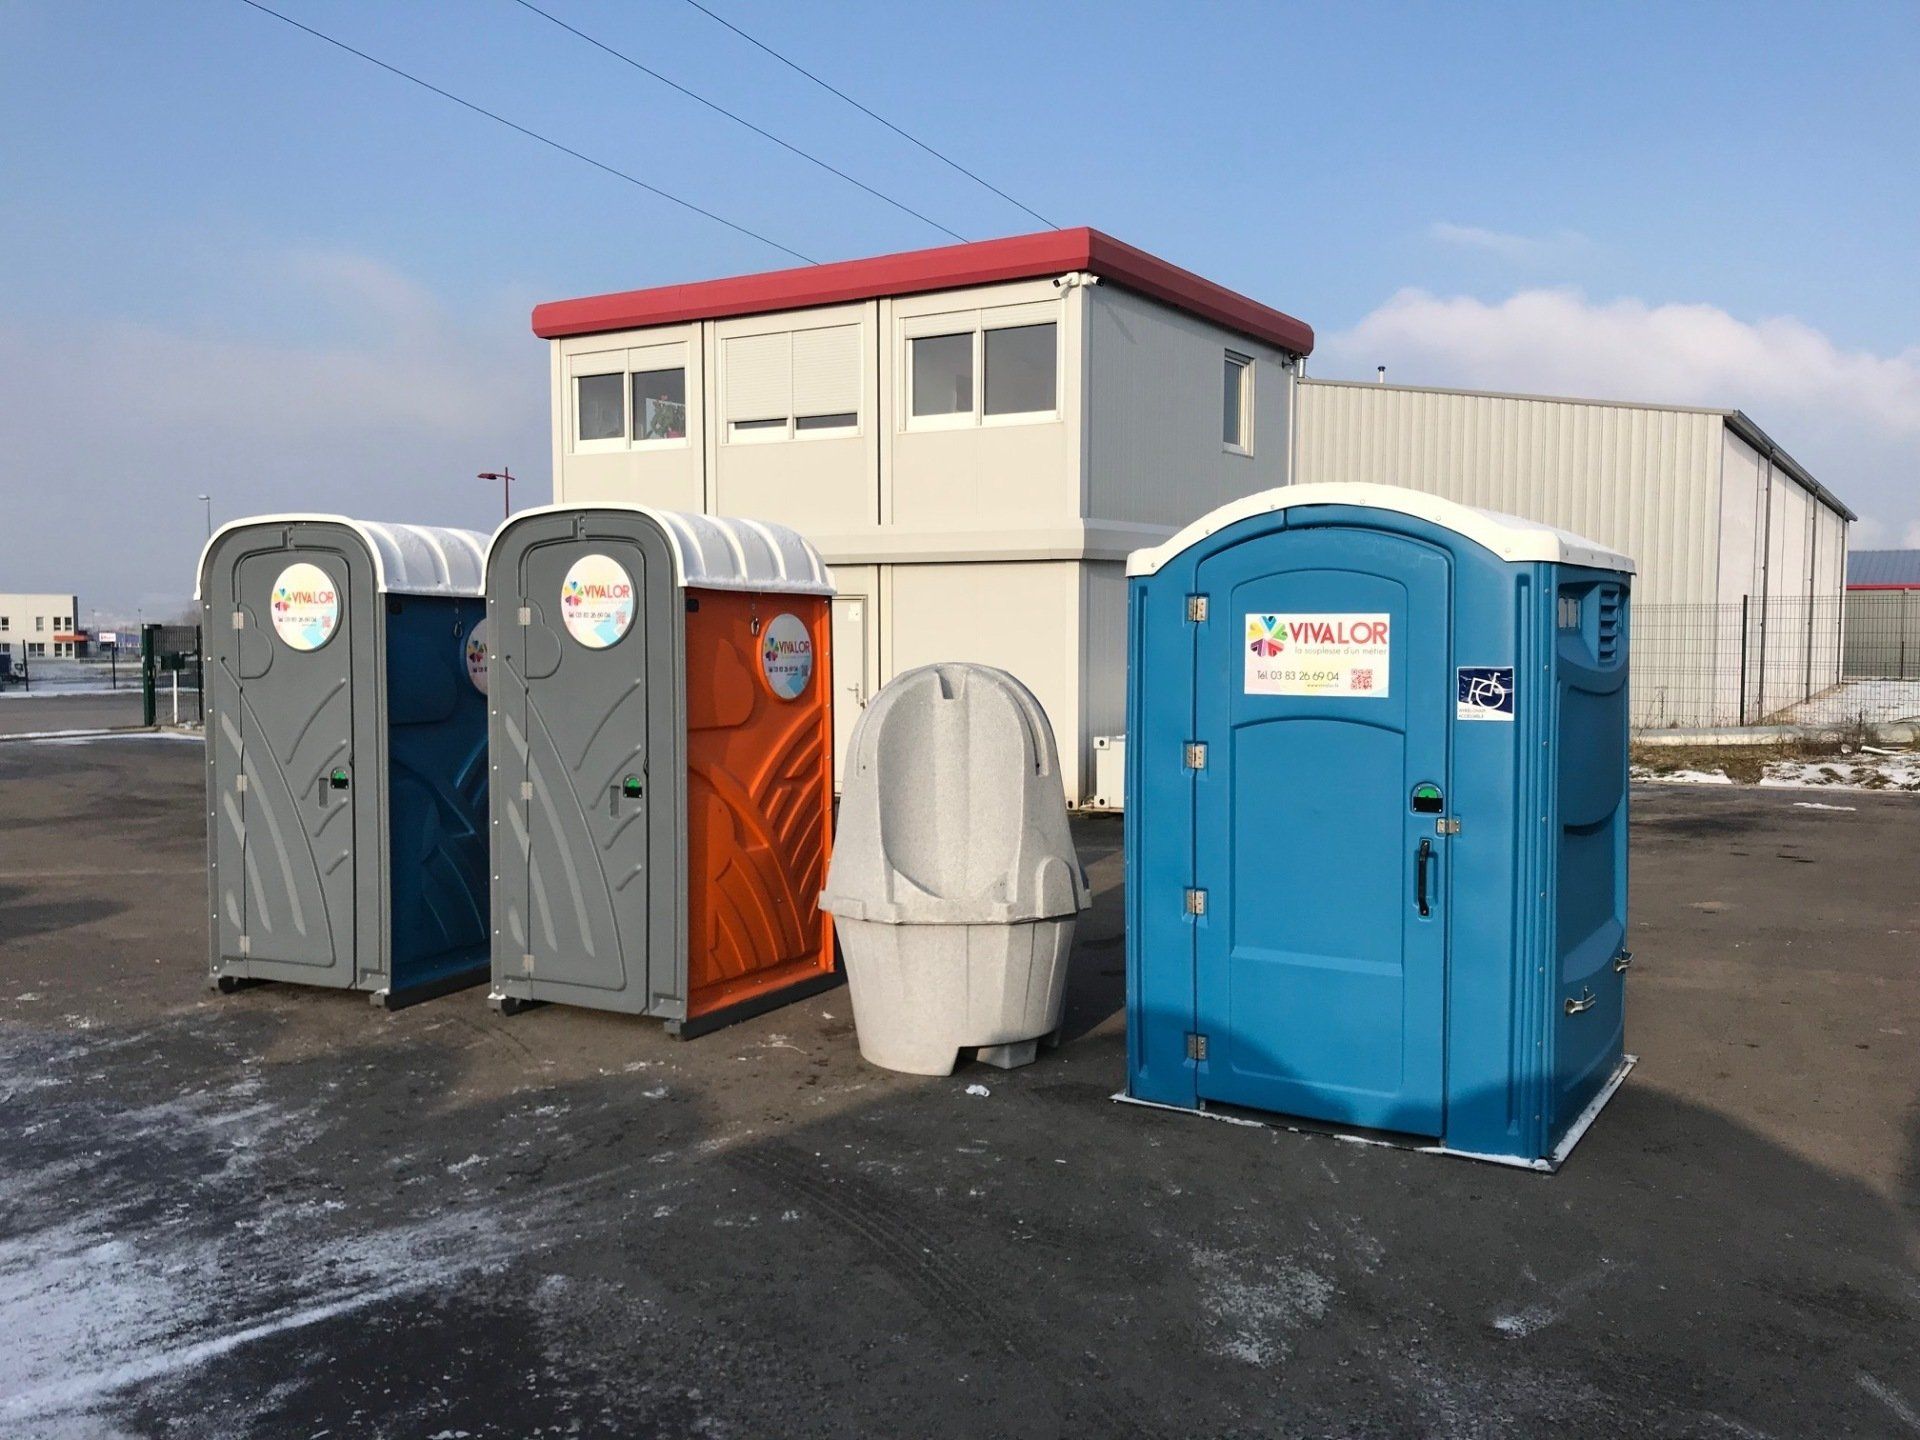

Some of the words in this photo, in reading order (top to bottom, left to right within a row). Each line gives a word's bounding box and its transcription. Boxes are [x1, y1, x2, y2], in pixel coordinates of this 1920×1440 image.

[292, 591, 334, 604] VIVALOR
[584, 585, 630, 598] VIVALOR
[1289, 622, 1387, 644] VIVALOR
[779, 641, 809, 654] VIVALOR
[1270, 671, 1282, 680] 03
[1284, 671, 1296, 680] 83
[1299, 671, 1310, 681] 26
[1312, 671, 1325, 681] 69
[1326, 671, 1339, 681] 04
